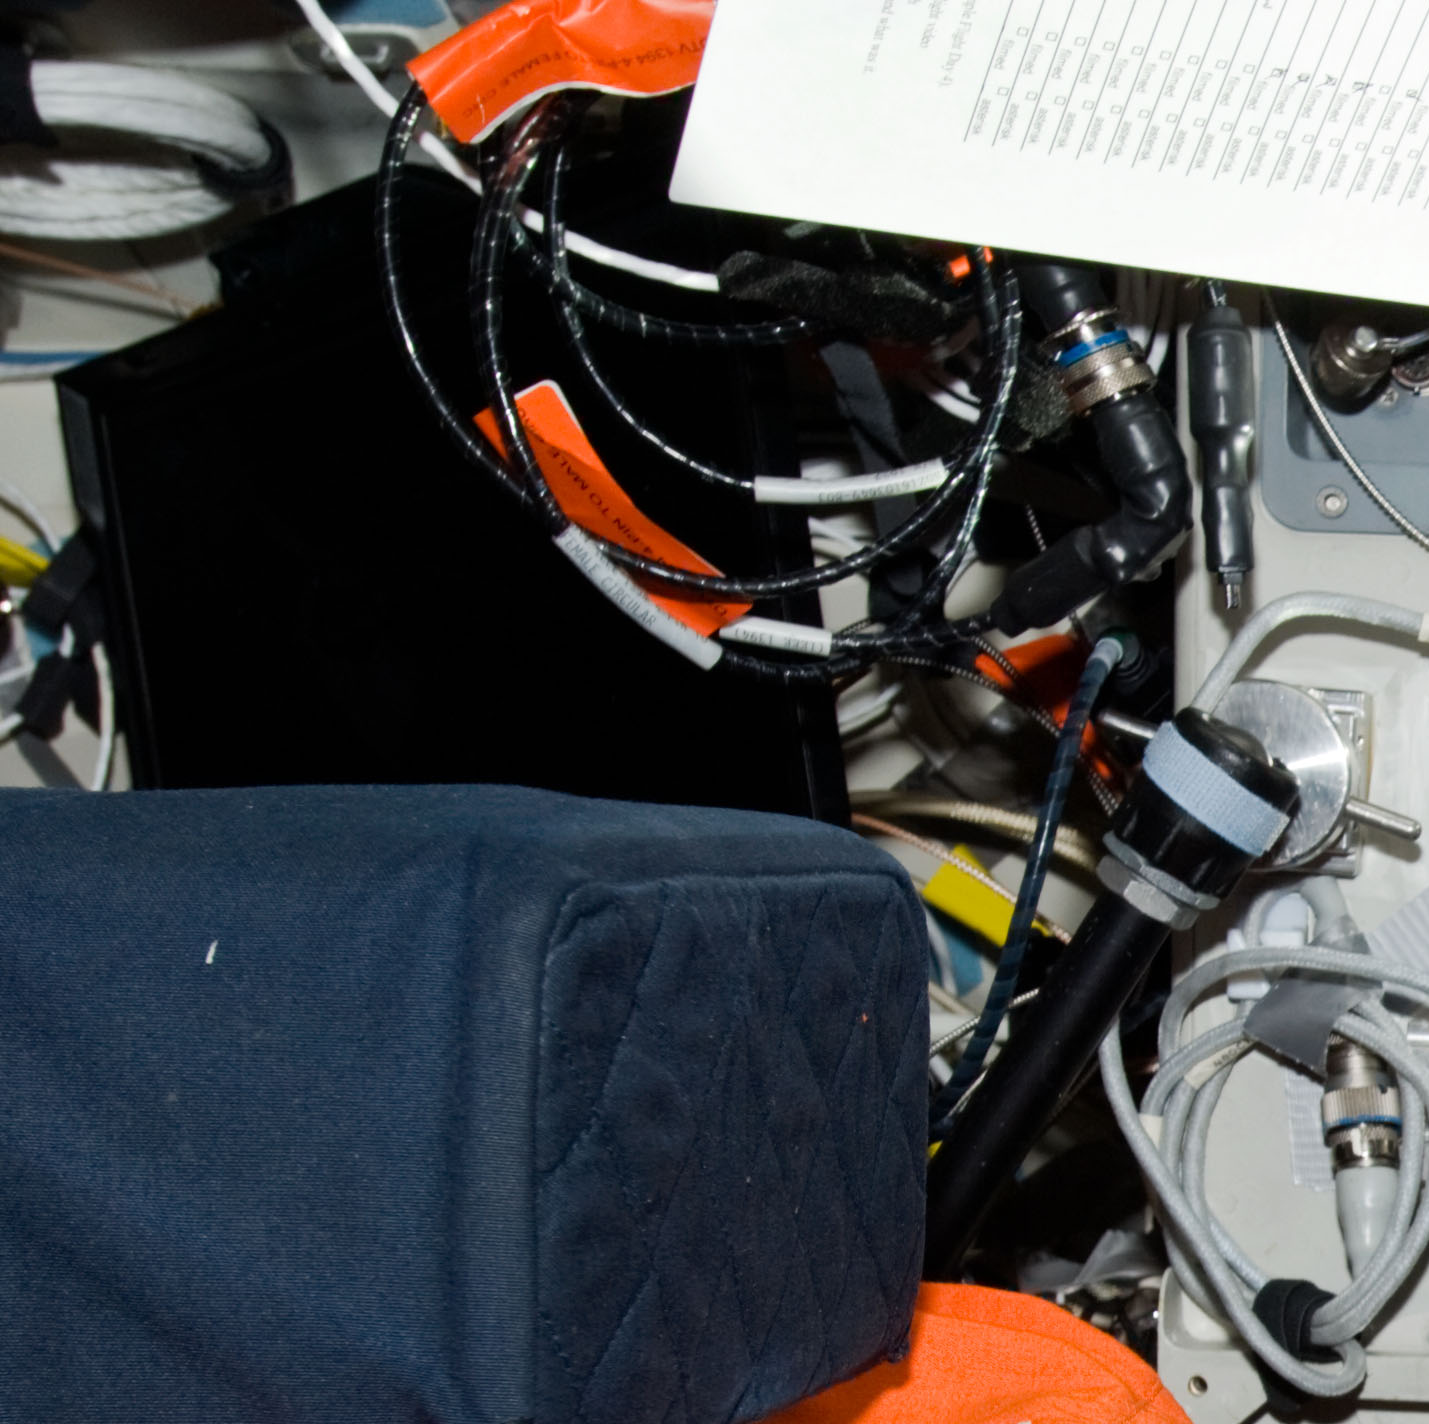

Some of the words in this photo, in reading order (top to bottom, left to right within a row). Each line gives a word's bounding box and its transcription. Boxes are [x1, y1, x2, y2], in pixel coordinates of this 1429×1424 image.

[994, 39, 1015, 71] filmed
[1080, 54, 1101, 84] filmed
[1163, 67, 1185, 98] filmed
[1247, 81, 1268, 111] filmed
[1328, 94, 1349, 123] filmed
